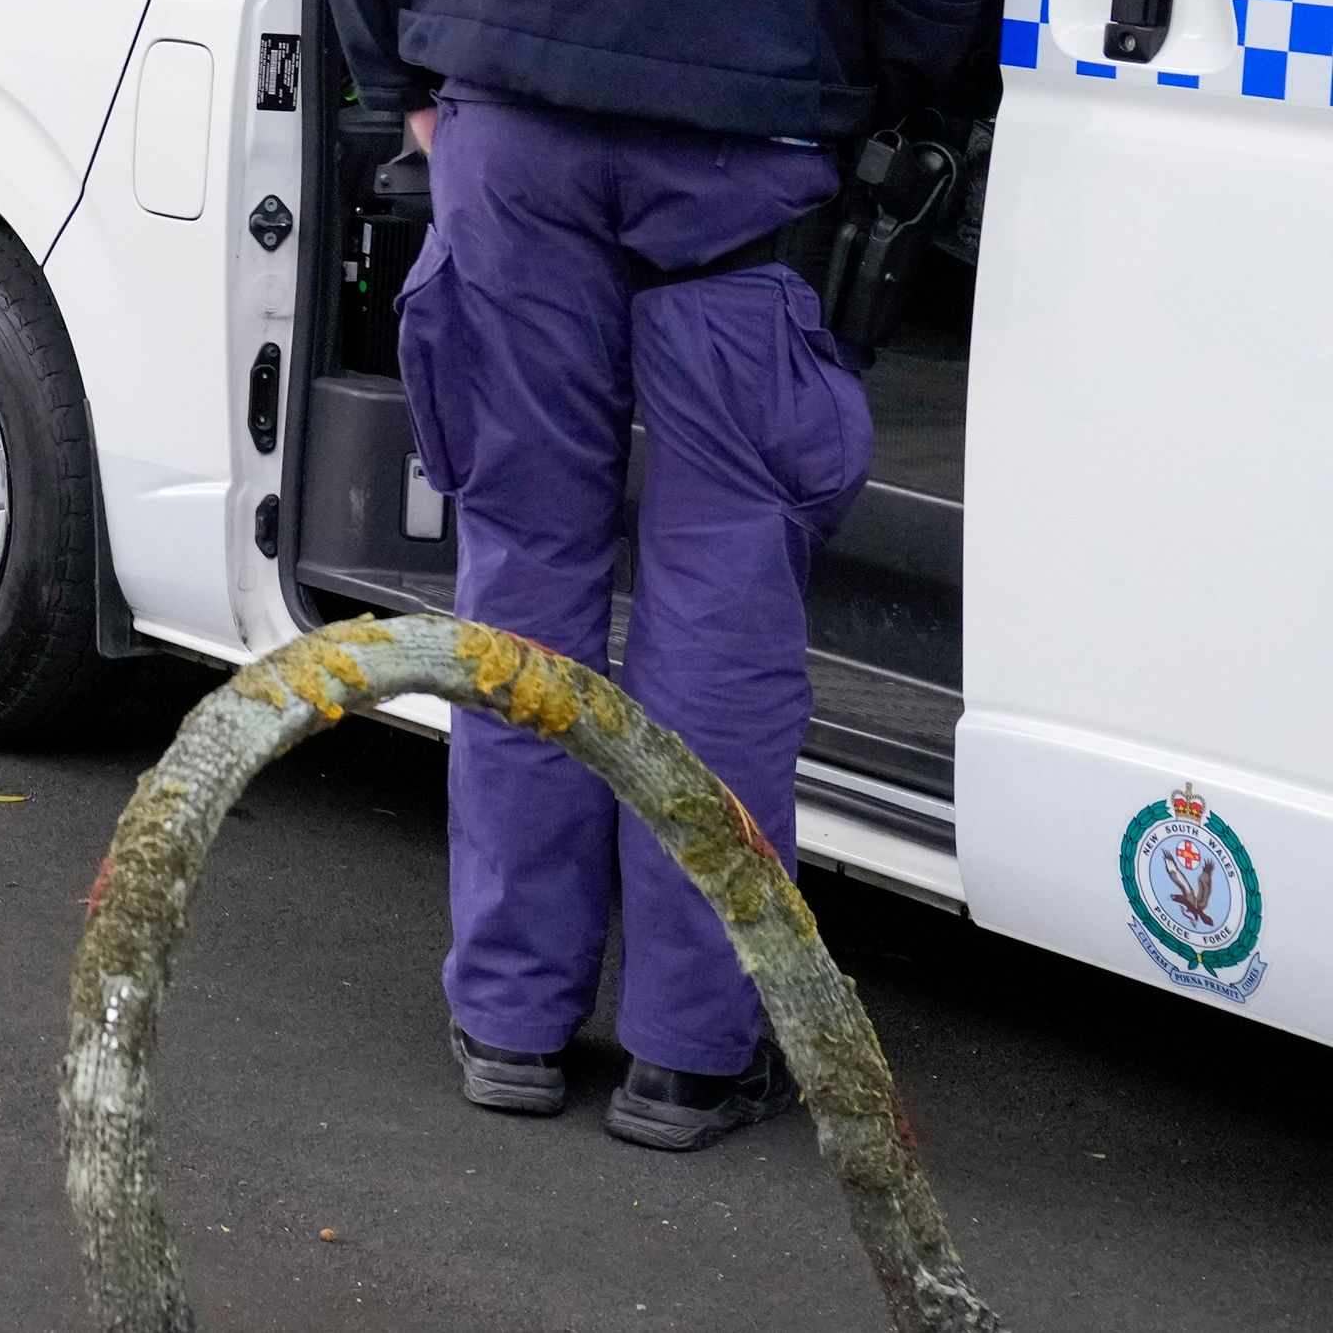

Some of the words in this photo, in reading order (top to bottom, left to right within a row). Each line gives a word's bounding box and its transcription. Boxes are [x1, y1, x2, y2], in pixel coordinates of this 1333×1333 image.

[1142, 834, 1159, 857] NEW
[1165, 824, 1199, 837] SOUTH
[1208, 838, 1235, 878] WALES
[1154, 906, 1190, 940] POLICE
[1203, 927, 1232, 945] FORCE
[1138, 931, 1168, 970] CULPAM
[1174, 972, 1204, 986] POENA
[1242, 967, 1261, 992] COMES
